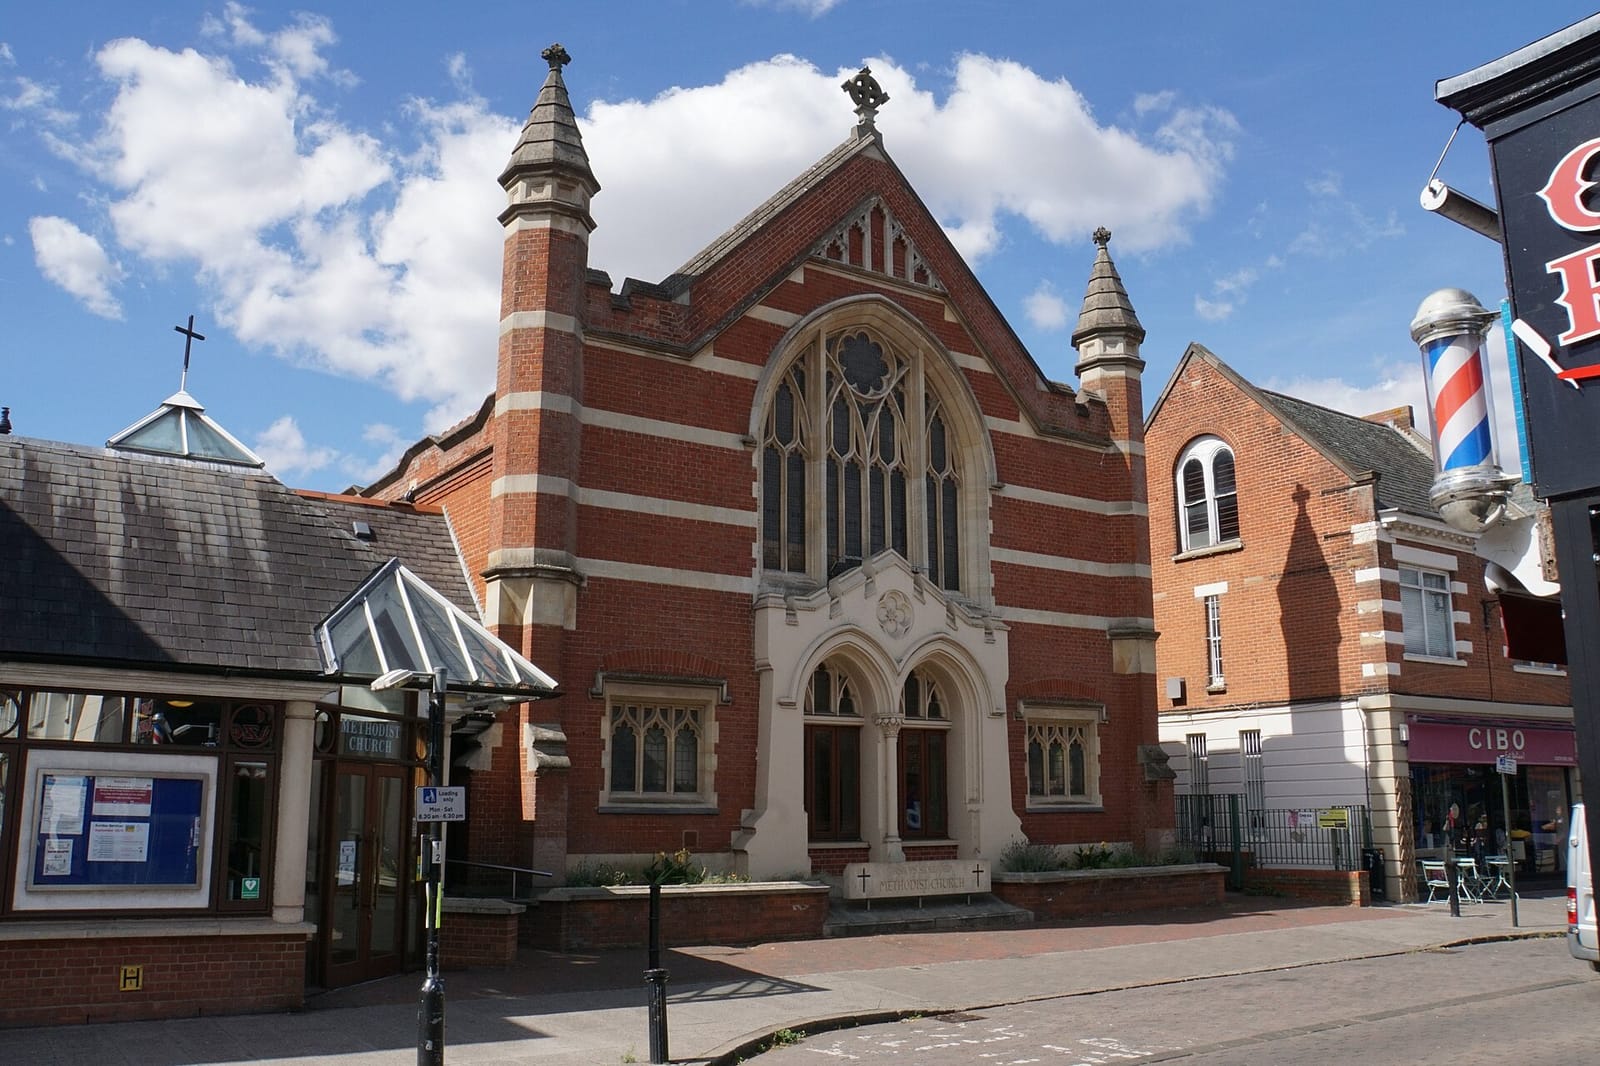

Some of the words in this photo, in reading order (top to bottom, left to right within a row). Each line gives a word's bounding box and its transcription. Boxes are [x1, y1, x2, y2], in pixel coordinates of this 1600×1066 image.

[342, 719, 401, 739] METHODIST
[349, 736, 392, 753] CHURCH
[1469, 728, 1525, 751] CIBO
[435, 854, 441, 862] 2
[880, 878, 929, 892] METHODIST
[930, 876, 965, 889] CHURCH
[123, 967, 140, 988] H
